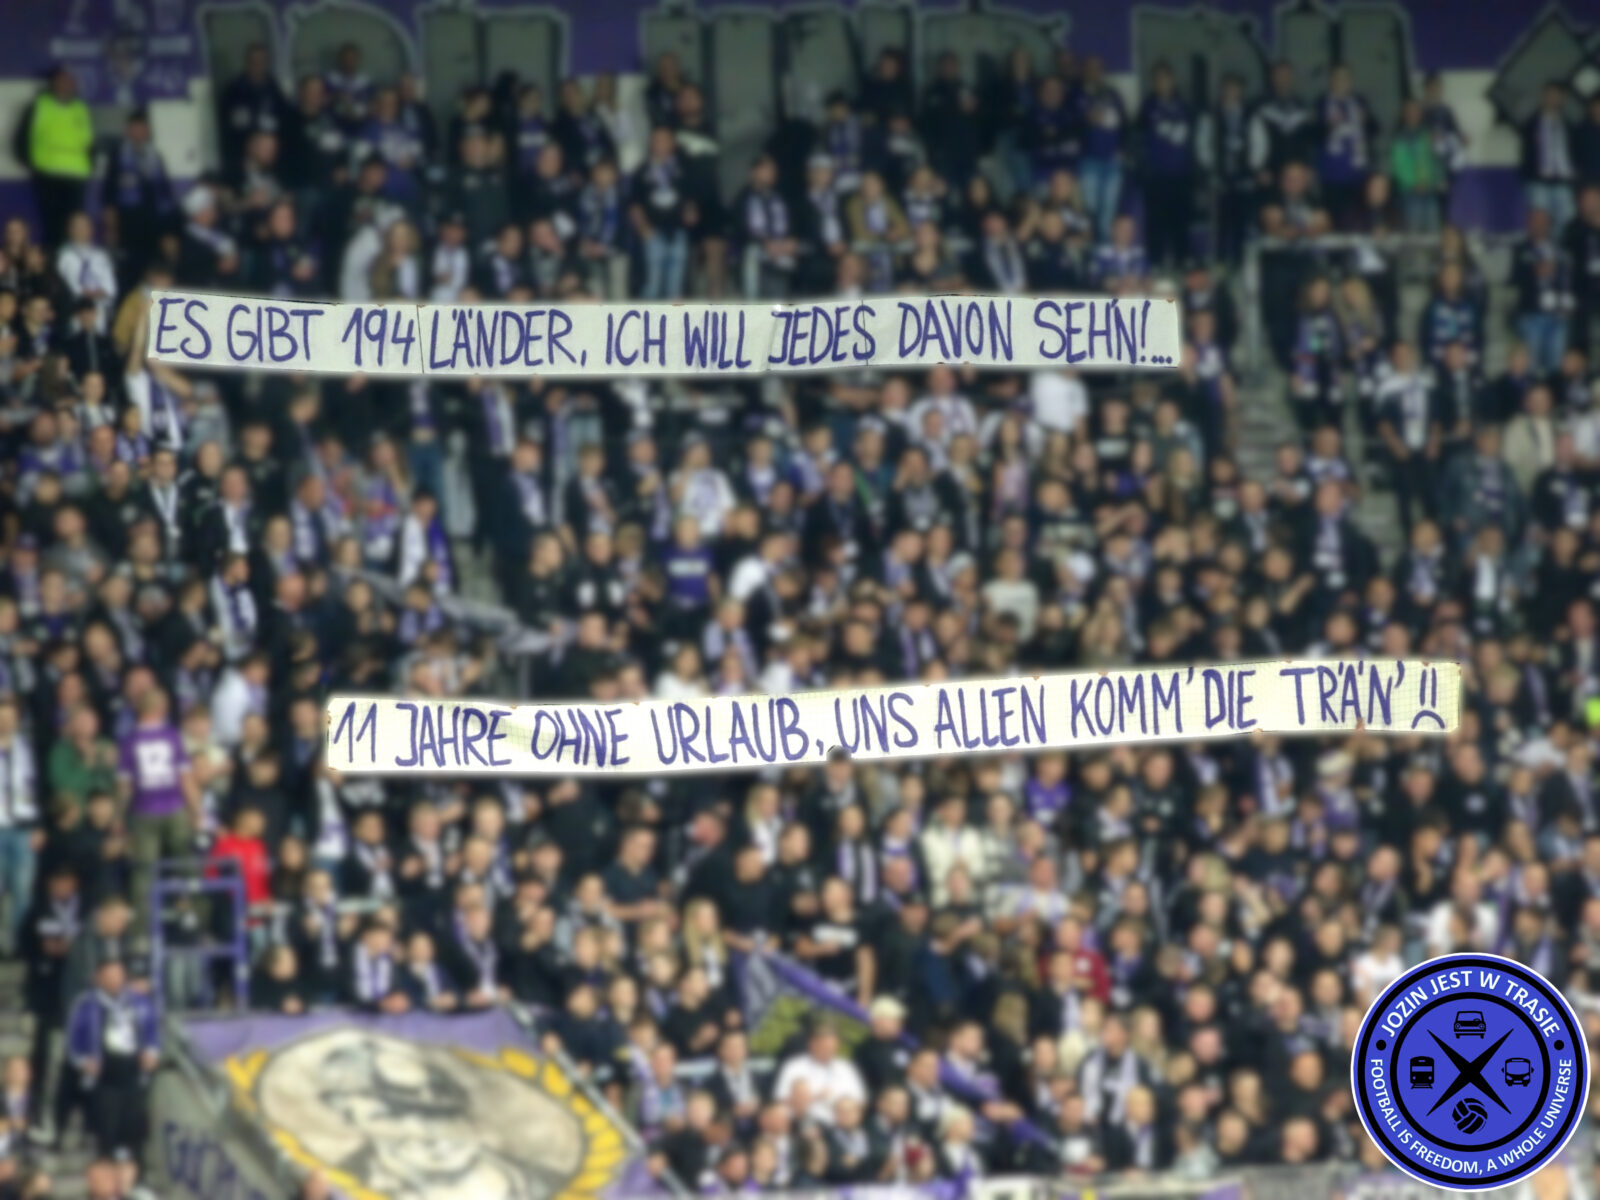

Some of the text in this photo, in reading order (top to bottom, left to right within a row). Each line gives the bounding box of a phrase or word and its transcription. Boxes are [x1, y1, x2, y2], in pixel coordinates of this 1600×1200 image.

[155, 298, 212, 360] ES
[227, 304, 325, 363] GIBT
[341, 307, 416, 367] 194
[430, 309, 587, 369] LÄNDER,
[605, 310, 667, 367] ICH
[684, 310, 752, 369] WILL
[768, 304, 875, 366] JEDES
[898, 299, 1013, 361] DAVON
[333, 702, 377, 763] 11
[395, 703, 512, 767] JAHRE
[531, 708, 630, 768] OHNE
[651, 697, 824, 765] URLAUB,
[834, 692, 919, 754] UNS
[934, 684, 1047, 748] ALLEN
[1202, 669, 1257, 729] DIE
